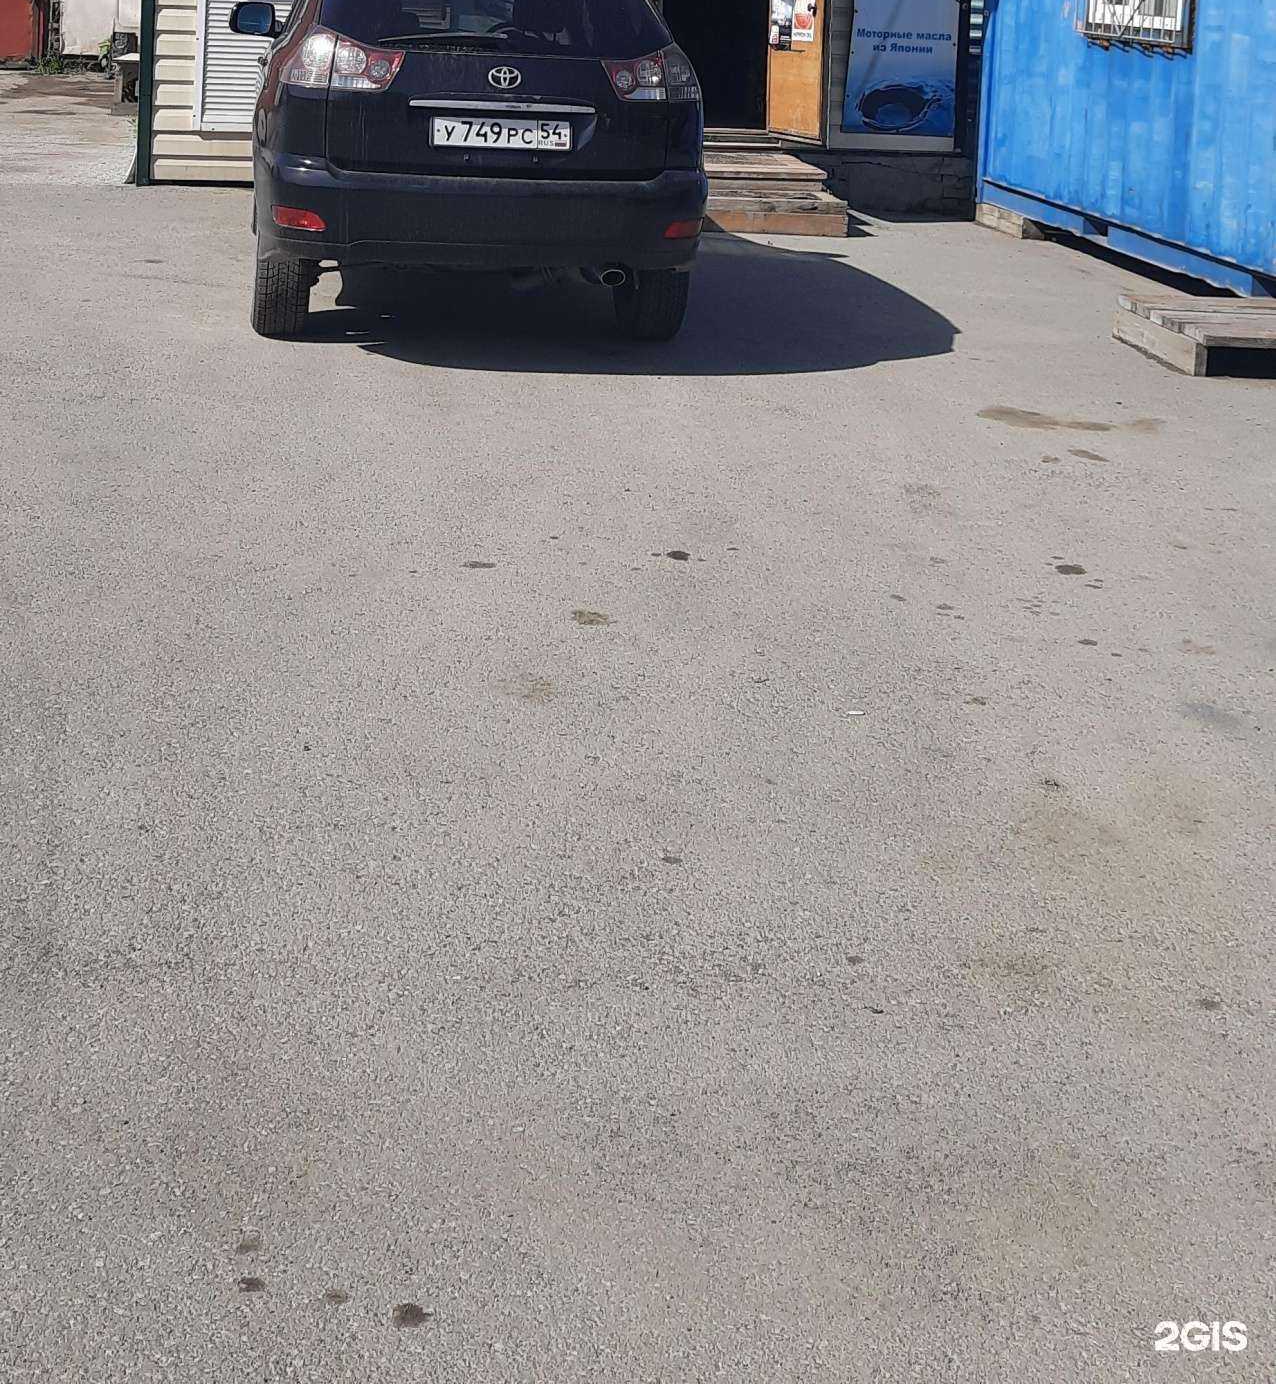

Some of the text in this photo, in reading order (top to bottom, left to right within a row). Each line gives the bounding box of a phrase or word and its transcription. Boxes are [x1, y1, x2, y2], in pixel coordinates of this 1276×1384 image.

[856, 28, 952, 42] Моторные масла
[872, 43, 933, 54] из Японии
[540, 123, 562, 140] 54
